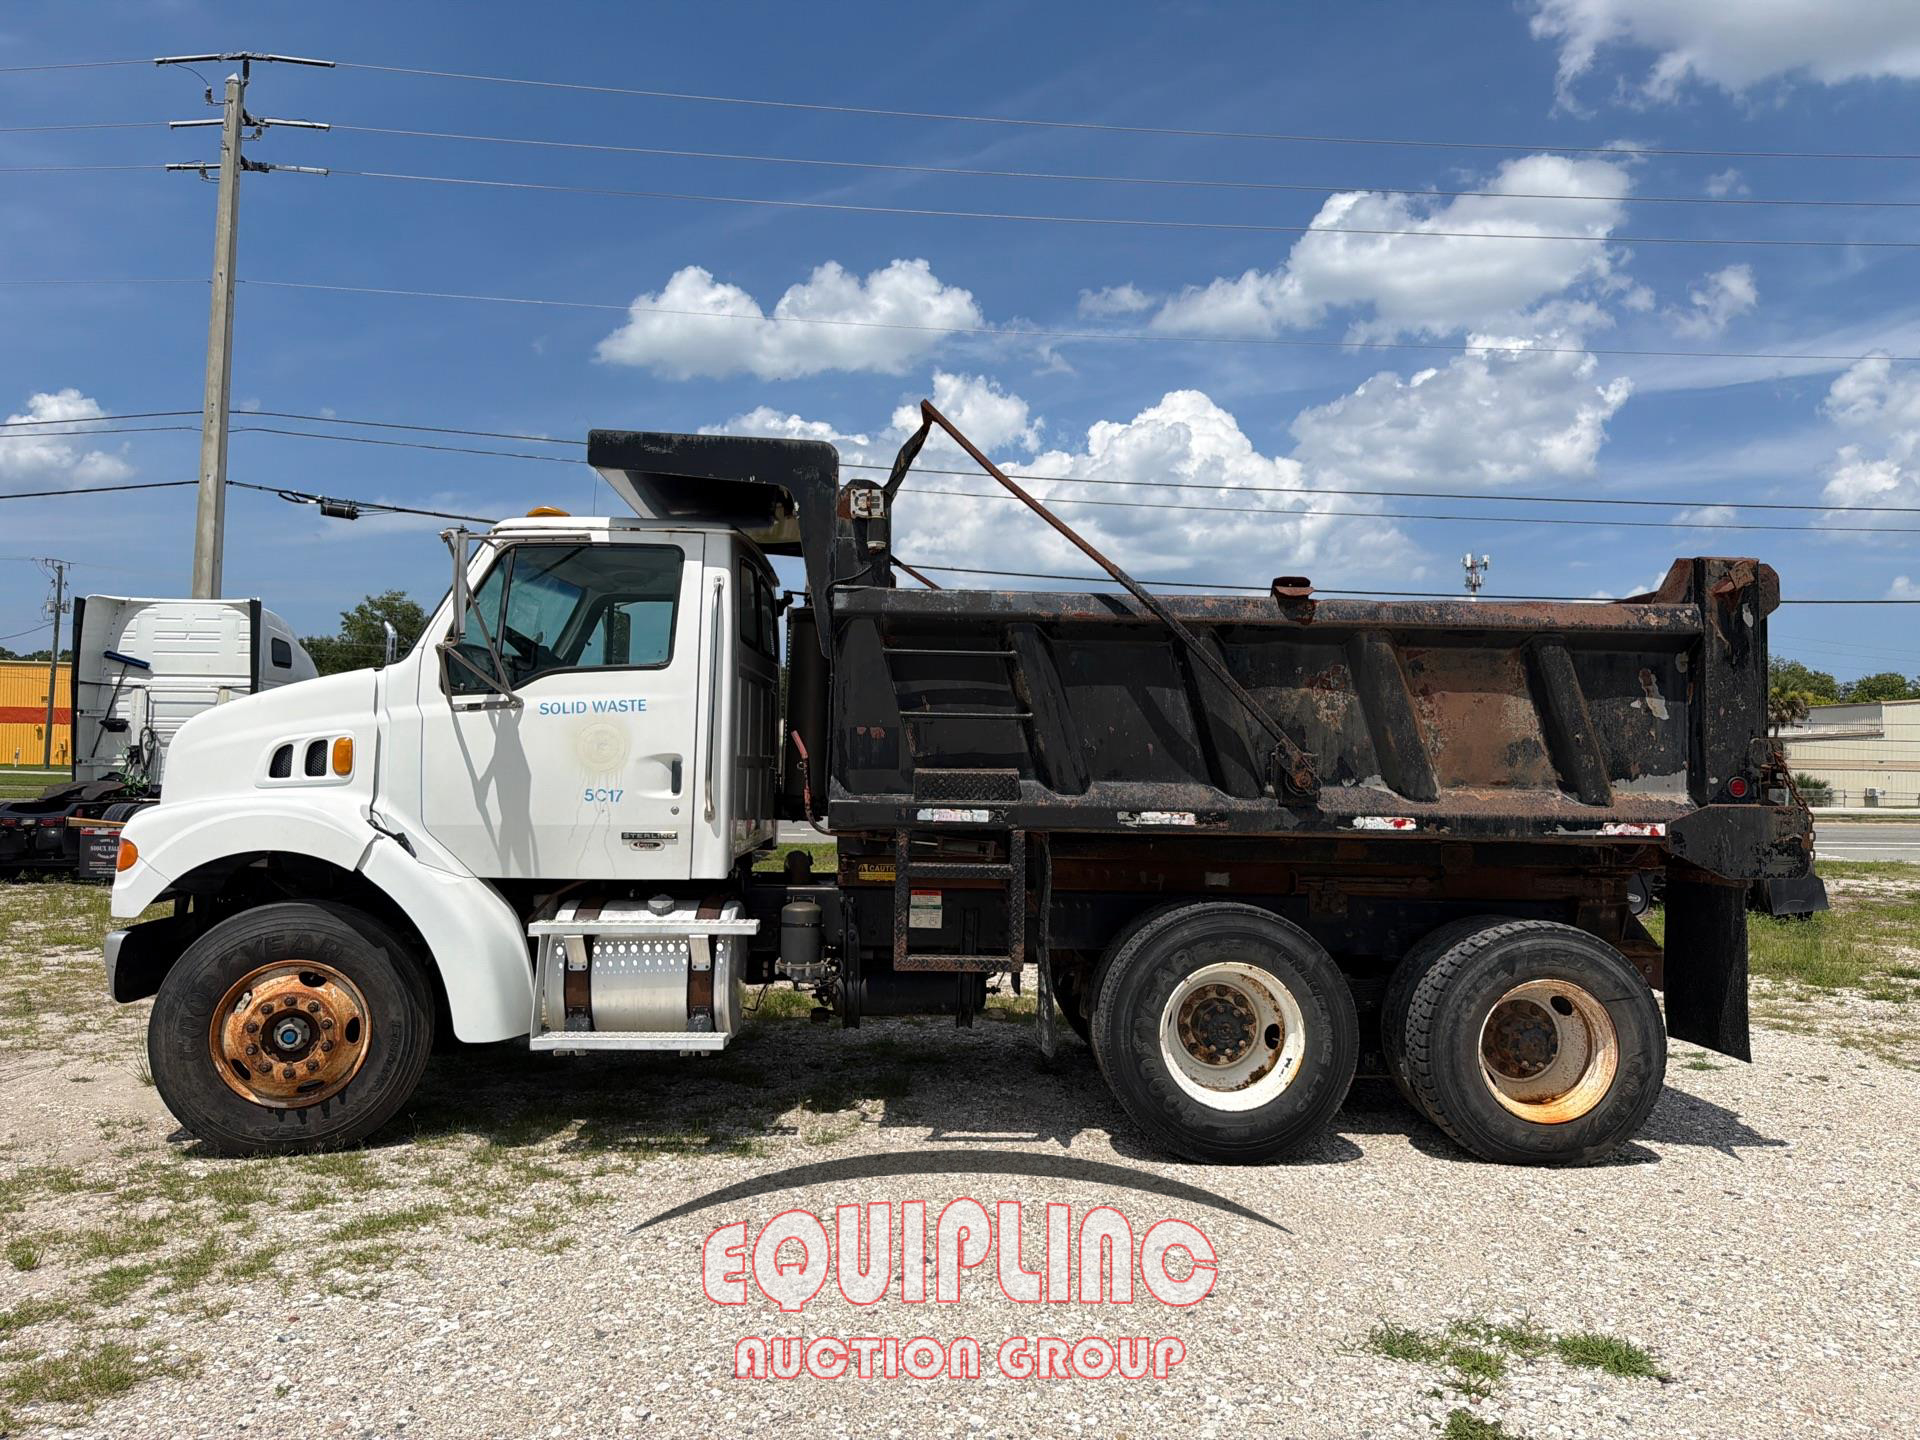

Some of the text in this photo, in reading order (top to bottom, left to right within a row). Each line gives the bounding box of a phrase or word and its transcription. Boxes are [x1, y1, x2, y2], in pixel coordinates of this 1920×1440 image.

[539, 699, 647, 715] SOLID WASTE
[584, 788, 624, 803] 5C17
